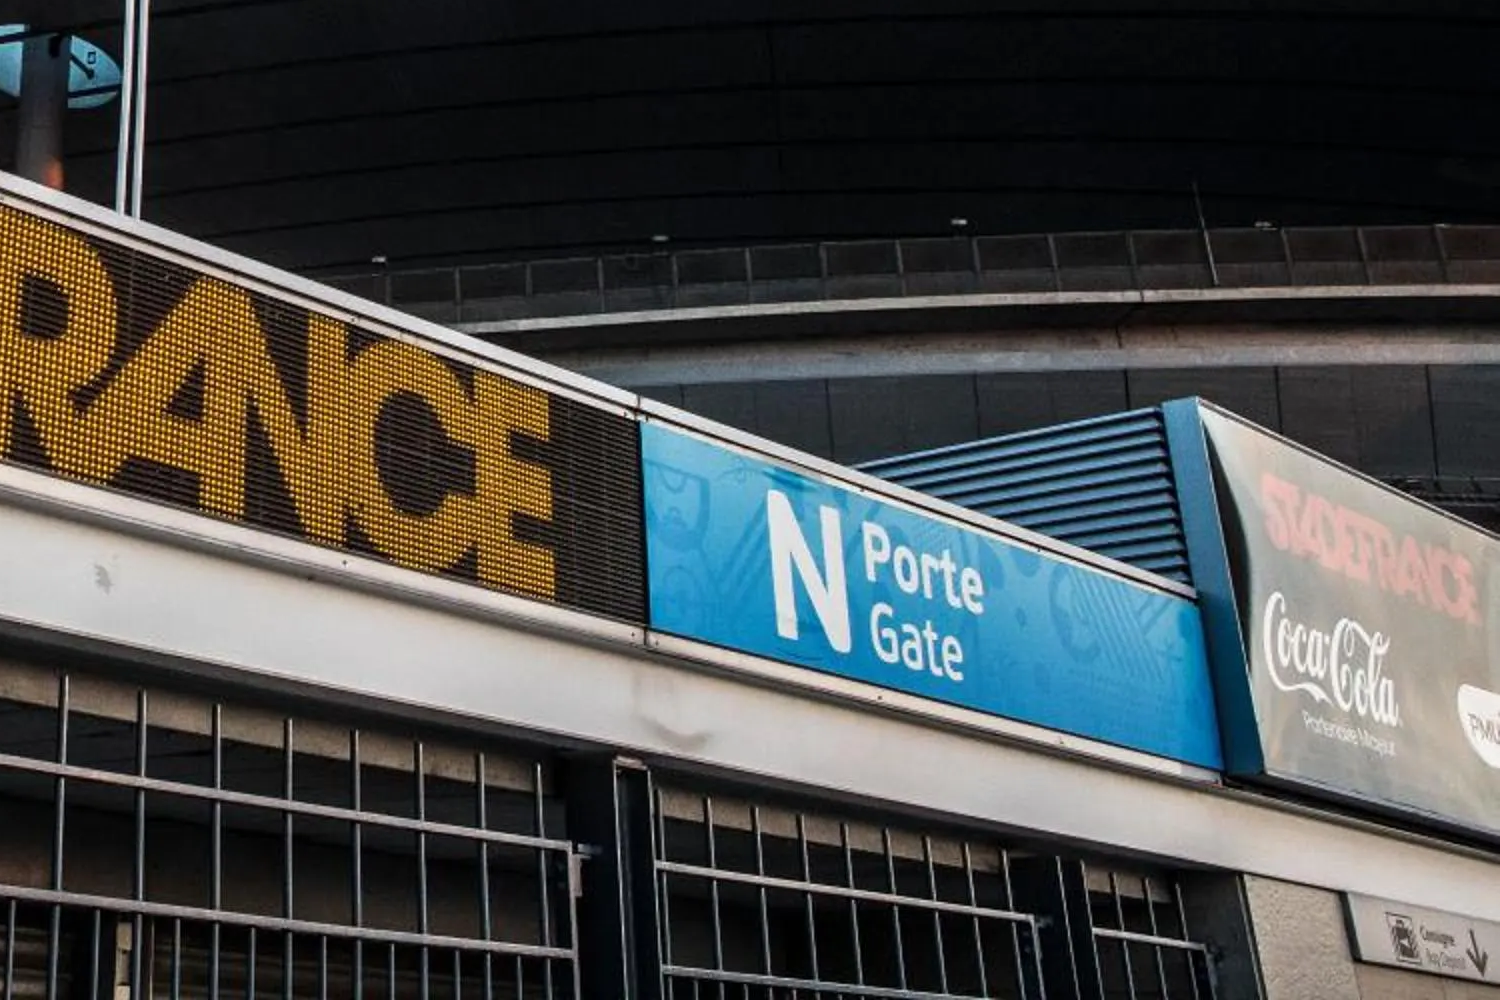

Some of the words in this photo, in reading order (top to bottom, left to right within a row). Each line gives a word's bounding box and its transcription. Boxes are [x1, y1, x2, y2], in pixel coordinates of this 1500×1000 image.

[766, 488, 852, 654] N
[861, 520, 985, 615] Porte
[869, 602, 964, 682] Gate
[1263, 591, 1401, 728] Coca-Cola
